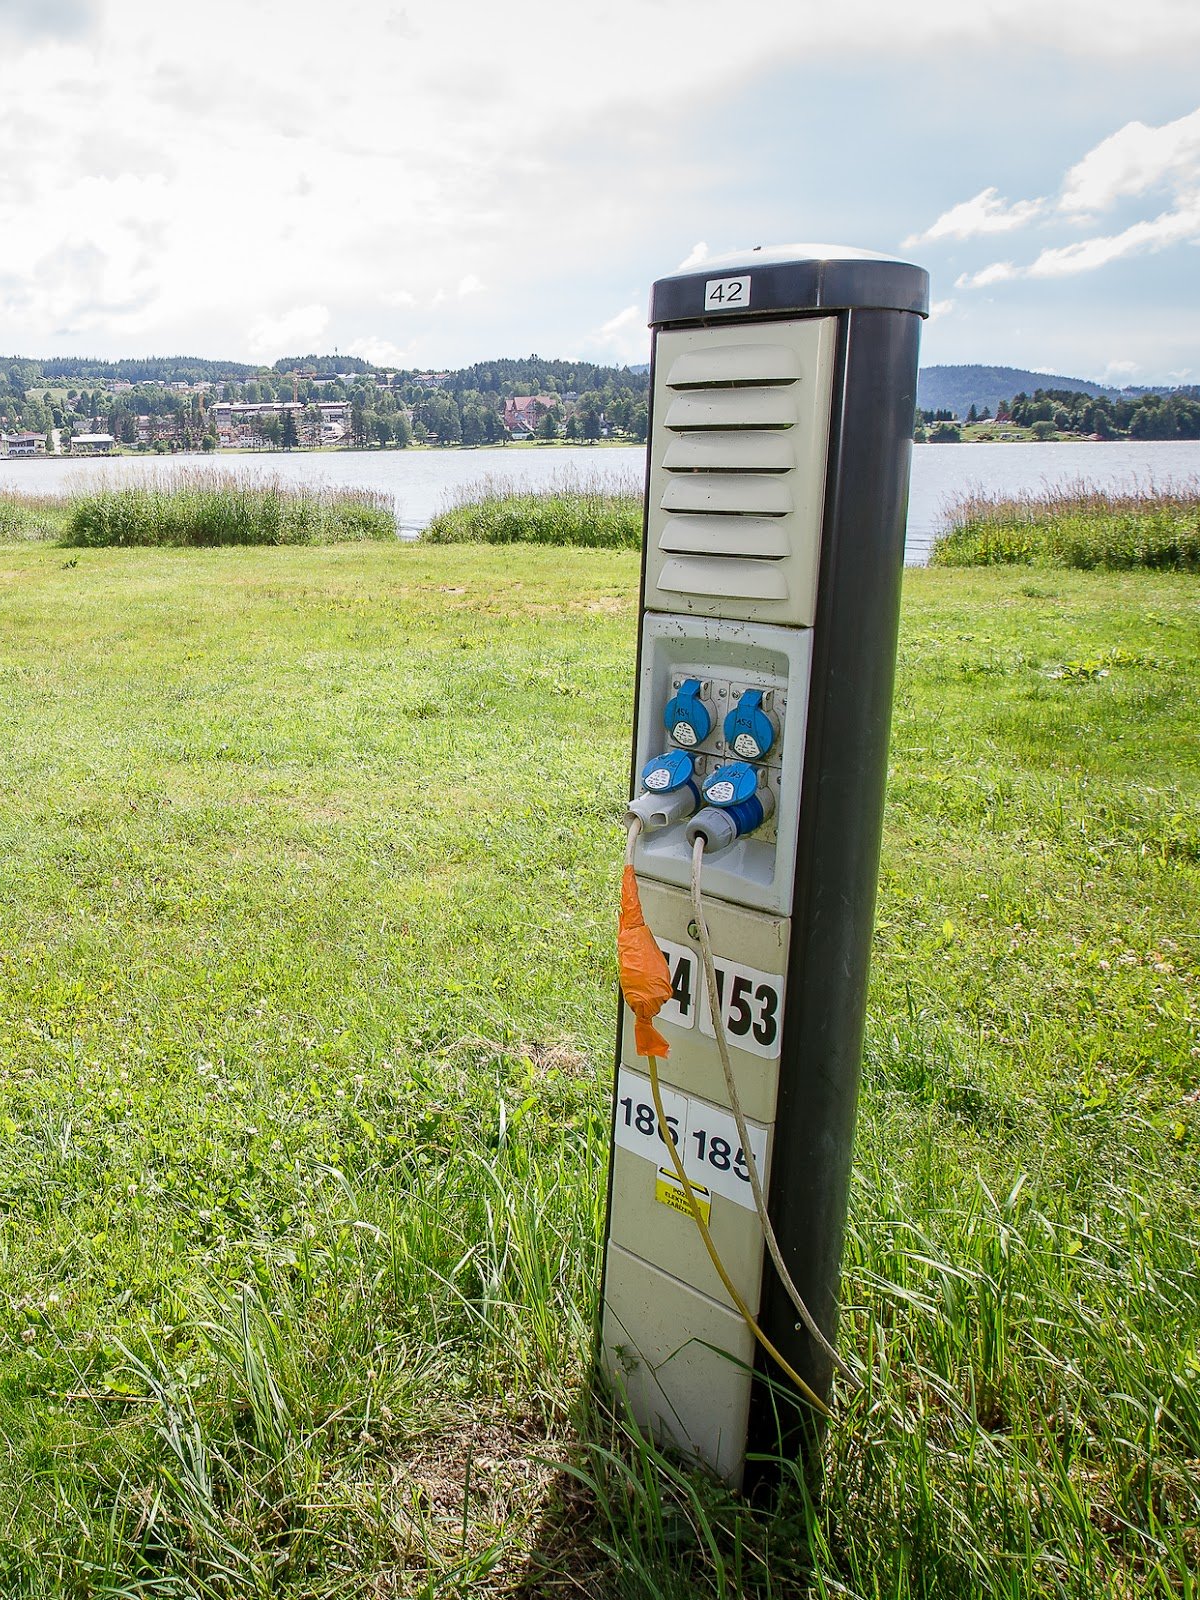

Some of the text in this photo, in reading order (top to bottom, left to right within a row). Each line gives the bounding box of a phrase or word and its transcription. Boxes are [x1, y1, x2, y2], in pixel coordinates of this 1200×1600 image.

[710, 282, 742, 302] 42
[620, 1097, 679, 1147] 186
[693, 1129, 756, 1183] 185
